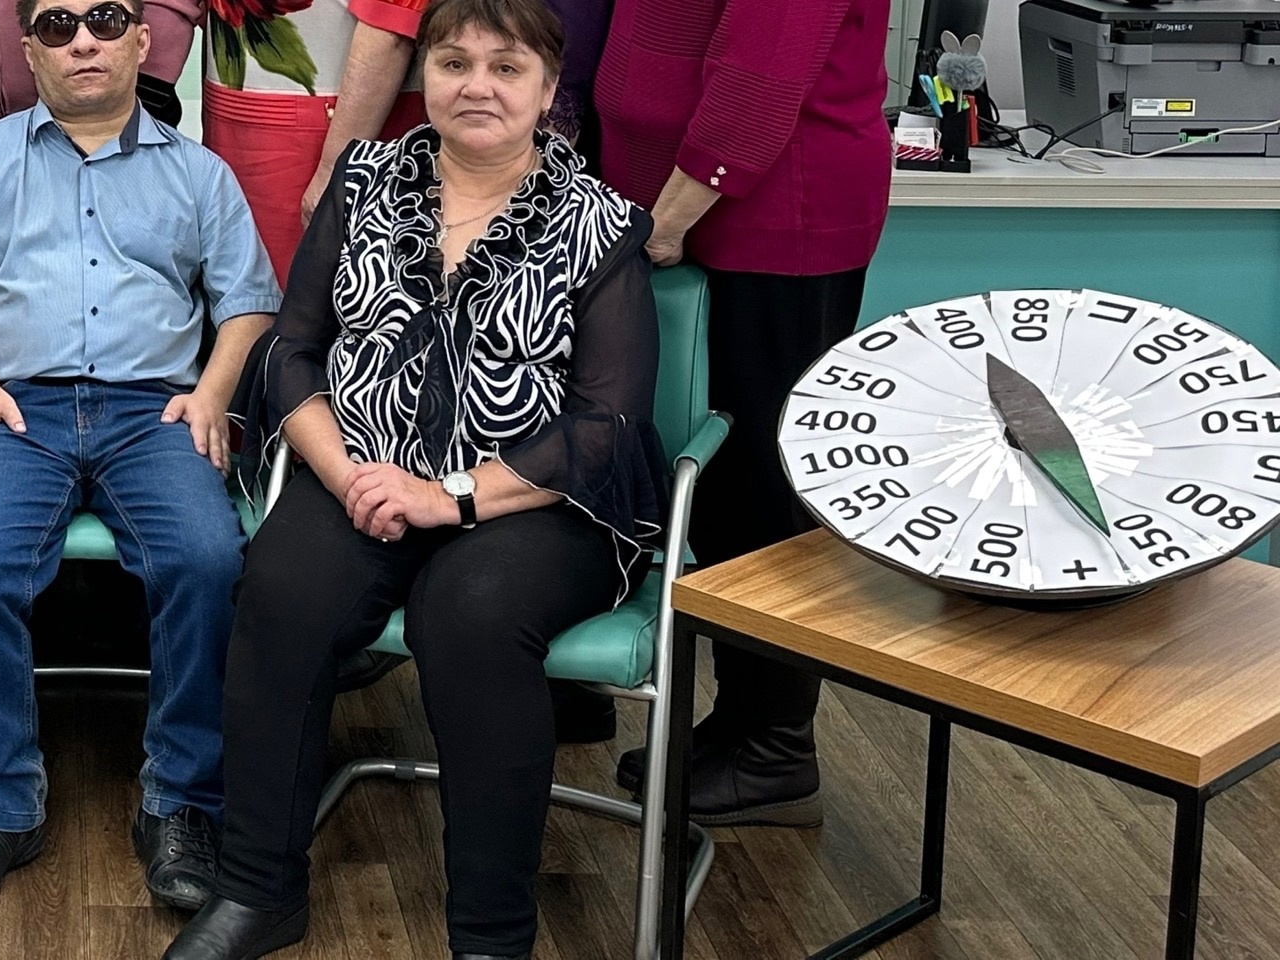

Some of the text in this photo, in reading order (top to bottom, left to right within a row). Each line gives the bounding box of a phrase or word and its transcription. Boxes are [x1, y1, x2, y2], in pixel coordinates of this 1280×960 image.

[858, 330, 898, 352] 0
[934, 308, 985, 350] 400
[1011, 298, 1050, 342] 850
[1133, 321, 1210, 365] 500
[816, 365, 897, 400] 550
[1179, 359, 1268, 395] 750
[795, 410, 877, 434] 400
[800, 443, 910, 475] 1000
[828, 478, 911, 521] 350
[1165, 483, 1257, 530] 800
[884, 505, 959, 557] 700
[969, 522, 1024, 578] 500
[1113, 513, 1191, 567] 350
